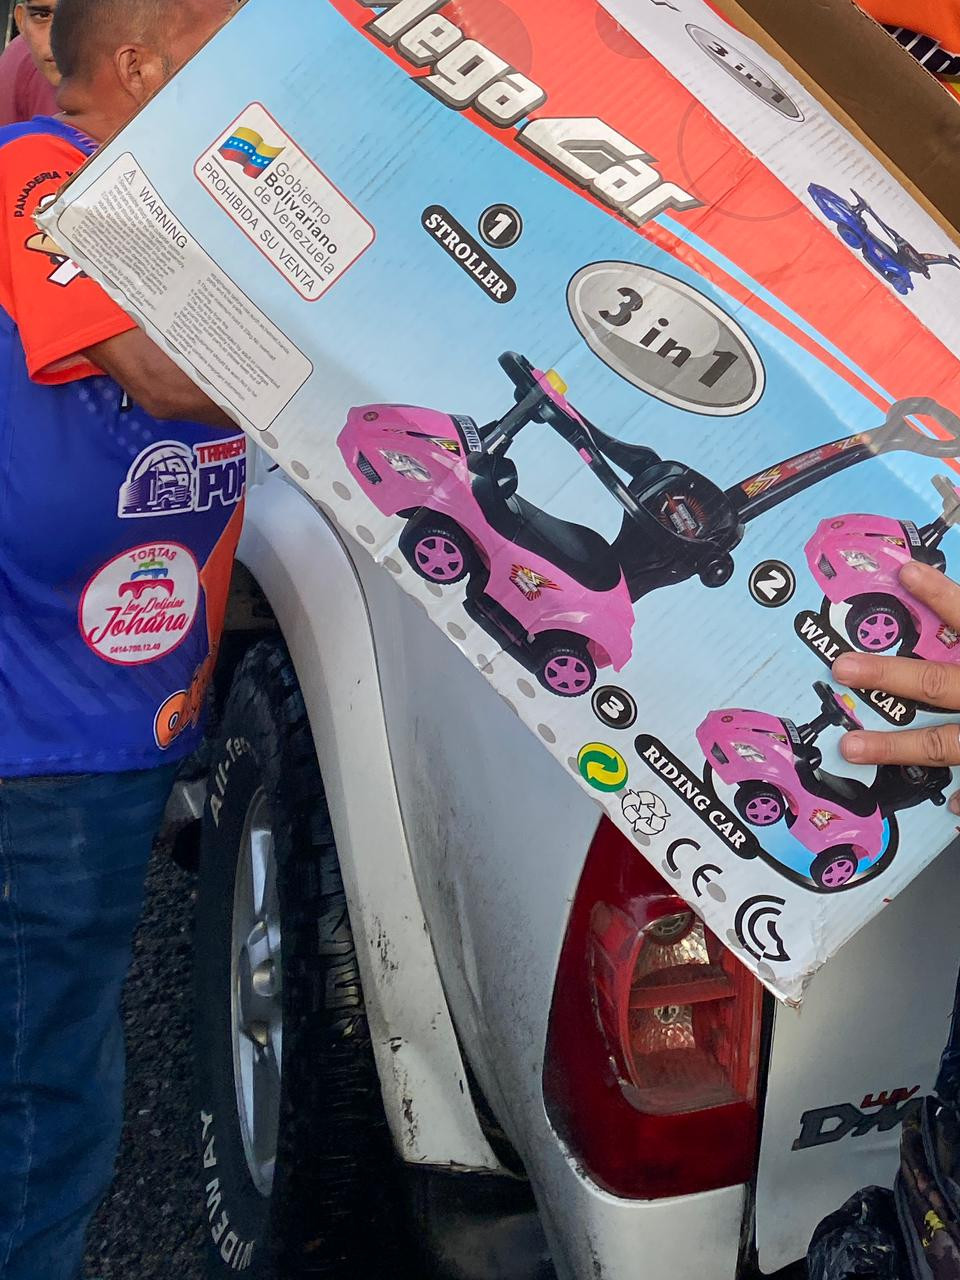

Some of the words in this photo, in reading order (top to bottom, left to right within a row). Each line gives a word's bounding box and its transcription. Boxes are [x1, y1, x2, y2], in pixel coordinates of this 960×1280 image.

[709, 41, 729, 58] 3
[735, 63, 763, 88] in
[771, 87, 785, 104] 1
[14, 170, 61, 217] PANADERIA
[275, 162, 331, 225] Gobierno
[514, 117, 707, 227] Car
[139, 186, 188, 249] WARNING
[201, 162, 259, 230] PROHIBIDA
[260, 229, 280, 250] SU
[279, 248, 315, 292] VENTA
[254, 186, 271, 205] de
[273, 201, 335, 275] Venezuela
[264, 171, 338, 254] Bolivariano
[489, 212, 513, 240] 1
[425, 213, 508, 300] STROLLER
[599, 287, 643, 326] 3
[639, 318, 693, 368] in
[698, 351, 739, 388] 1
[129, 547, 177, 563] TORTAS
[756, 569, 786, 601] 2
[88, 606, 189, 645] Johana
[600, 695, 625, 720] 3
[869, 689, 907, 722] CAR
[642, 744, 711, 811] RIDING
[709, 808, 748, 850] CAR
